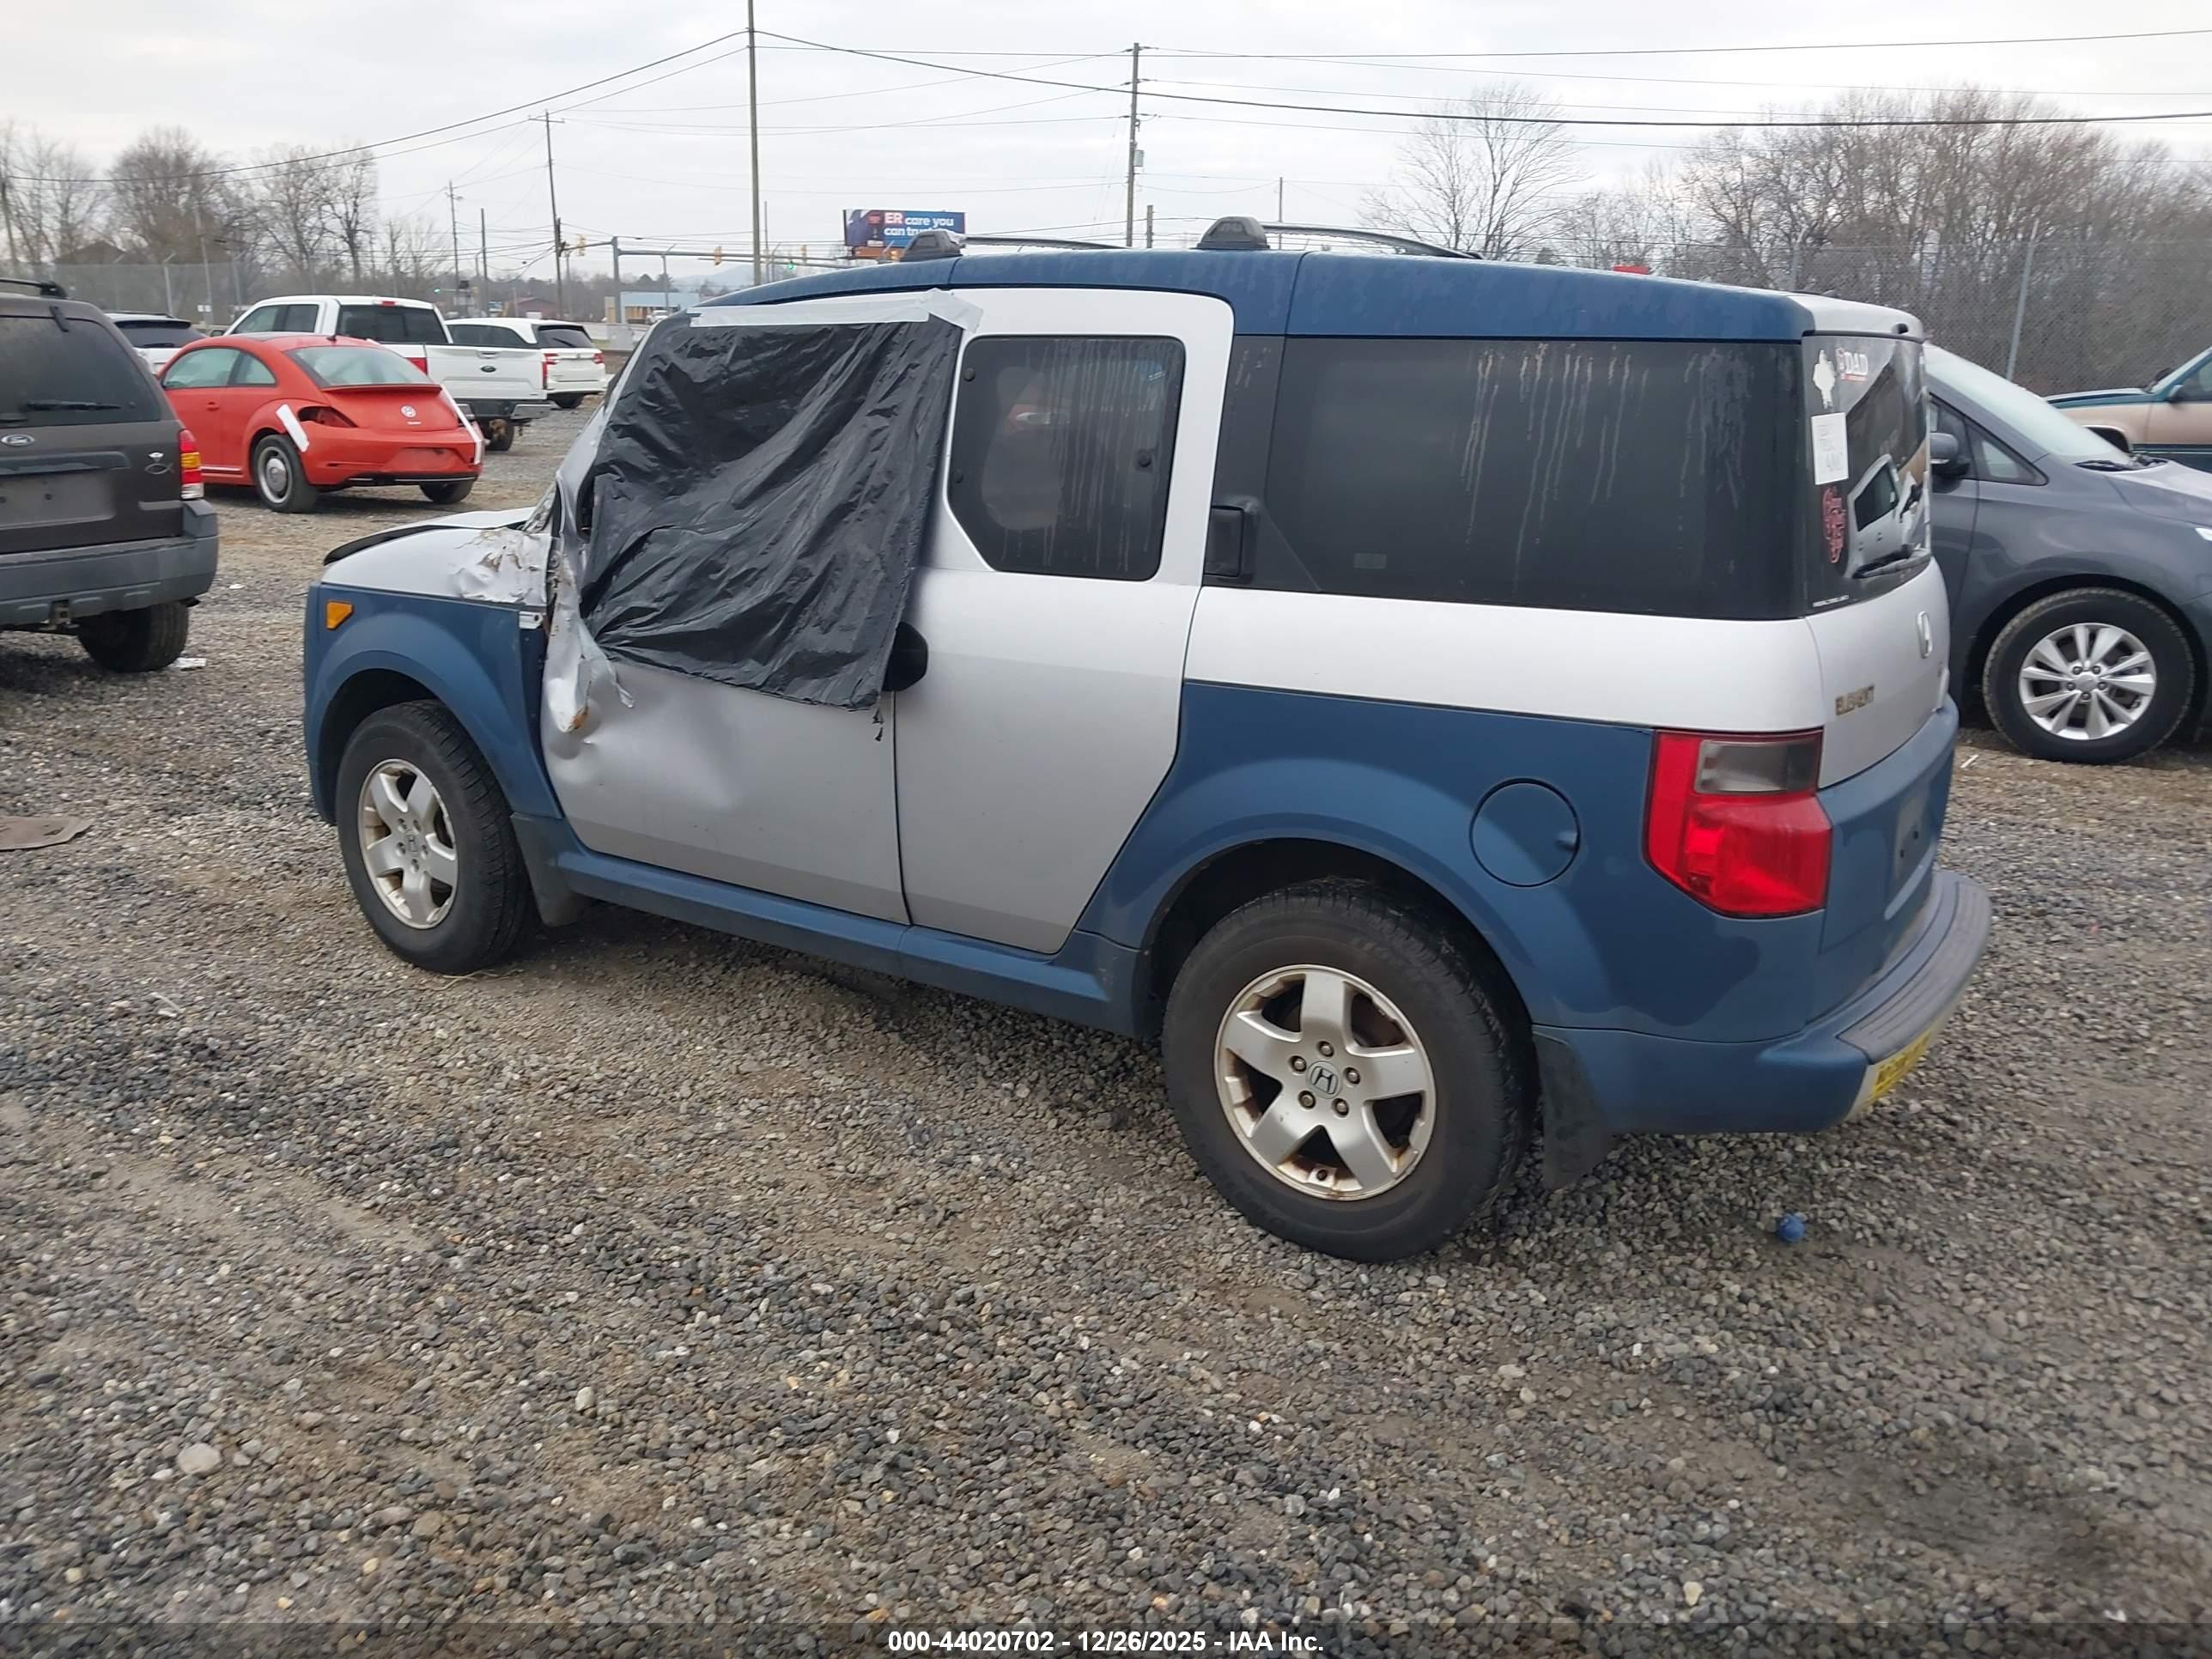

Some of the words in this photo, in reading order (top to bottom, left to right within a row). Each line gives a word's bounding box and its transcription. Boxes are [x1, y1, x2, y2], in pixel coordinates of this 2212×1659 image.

[884, 212, 903, 224] ER
[905, 216, 931, 226] care
[933, 217, 955, 228] you
[884, 227, 905, 236] can
